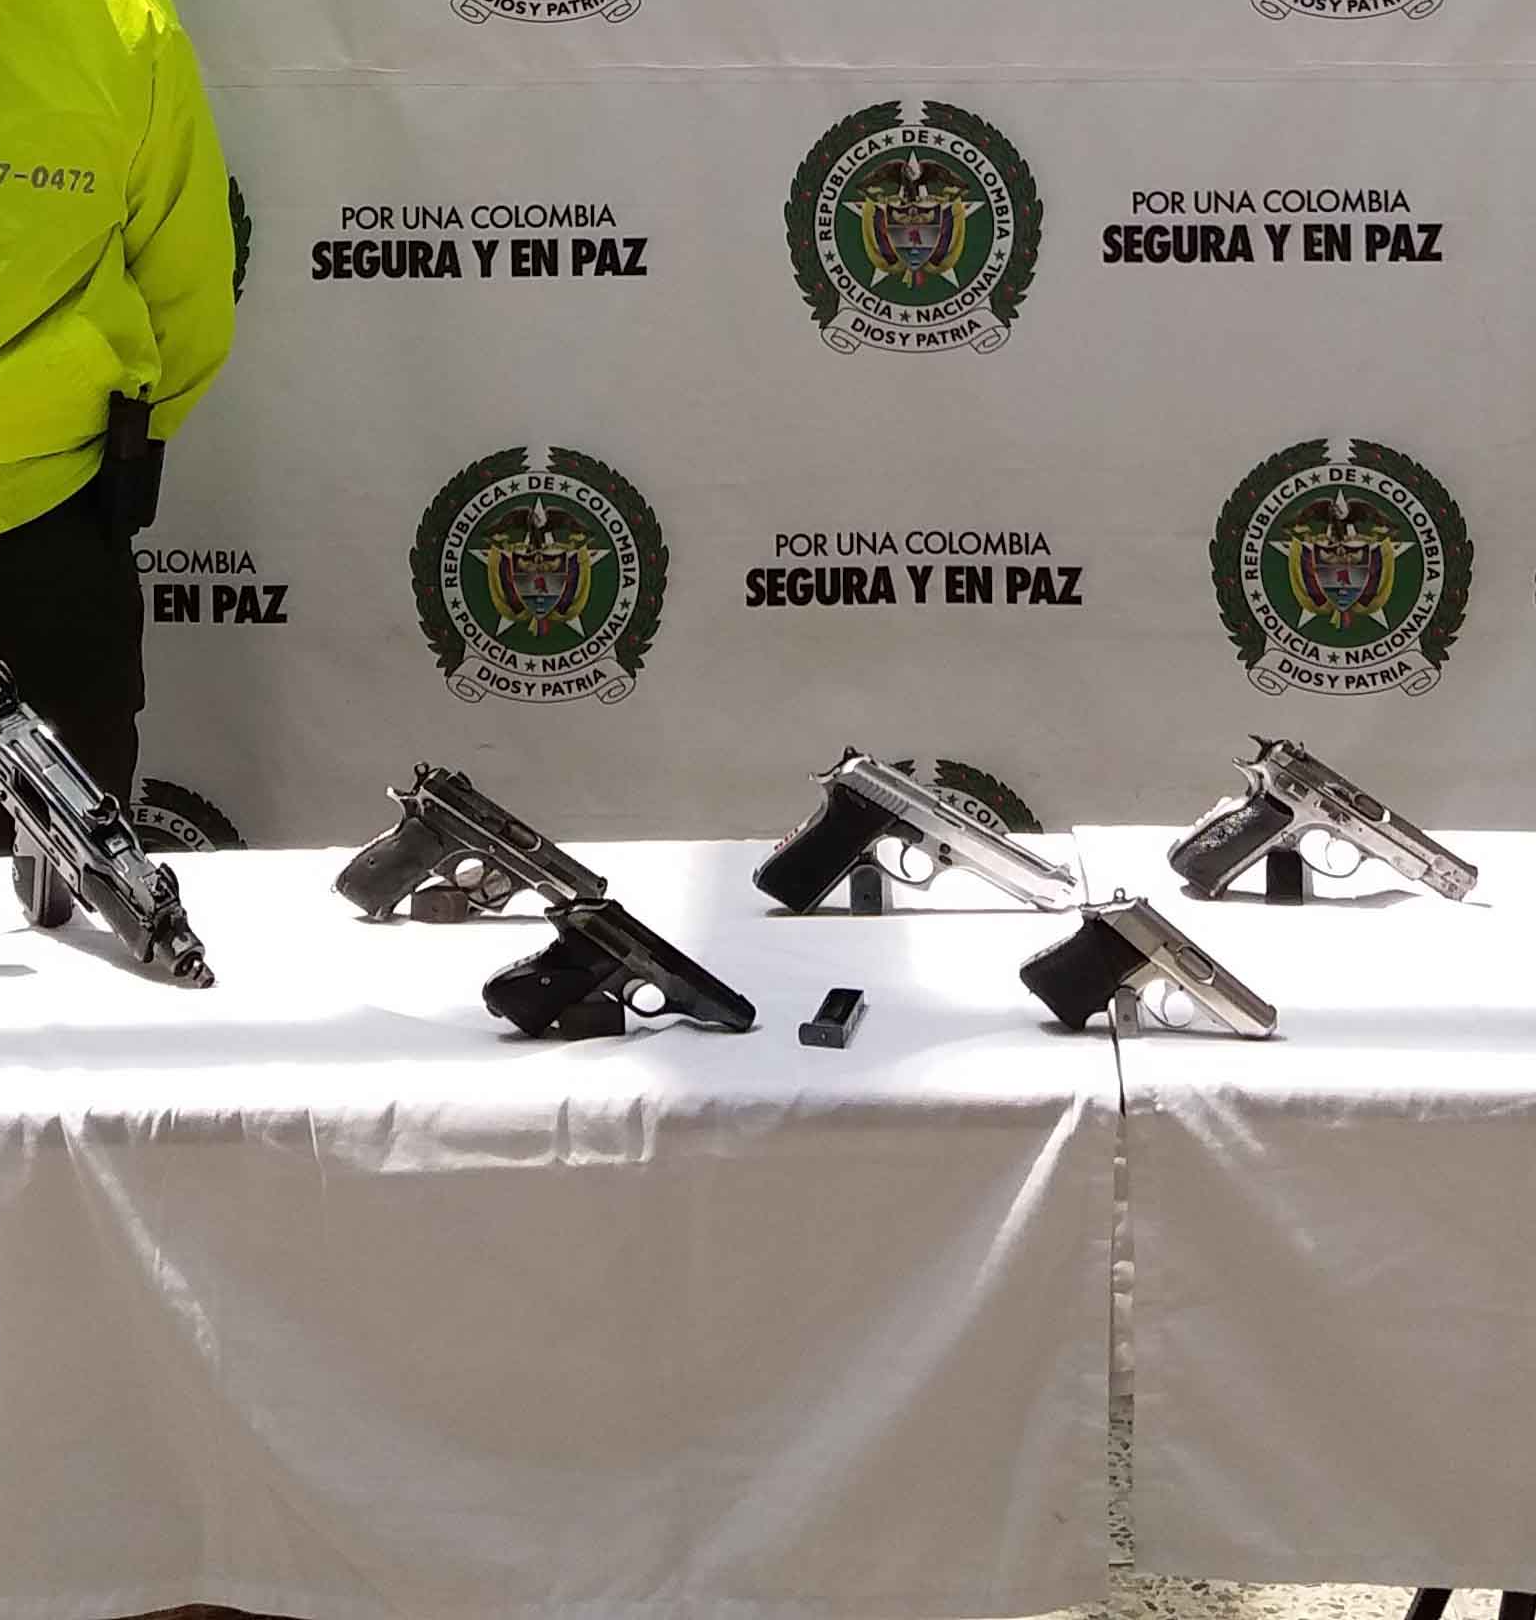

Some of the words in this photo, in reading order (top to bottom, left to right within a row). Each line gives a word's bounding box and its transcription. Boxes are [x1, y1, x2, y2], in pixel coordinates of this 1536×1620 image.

[341, 205, 396, 231] POR
[401, 204, 465, 231] UNA
[470, 203, 617, 230] COLOMBIA
[1131, 190, 1187, 215] POR
[1193, 189, 1257, 215] UNA
[1262, 188, 1412, 214] COLOMBIA
[311, 239, 464, 281] SEGURA
[471, 238, 501, 279] Y
[510, 237, 560, 278] EN
[571, 236, 649, 277] PAZ
[1101, 223, 1256, 265] SEGURA
[1263, 223, 1293, 263] Y
[1302, 222, 1353, 263] EN
[1364, 222, 1444, 263] PAZ
[528, 477, 555, 491] DE
[576, 487, 636, 589] COLOMBIA
[542, 606, 628, 673] NACIONAL
[542, 668, 607, 698] PATRIA
